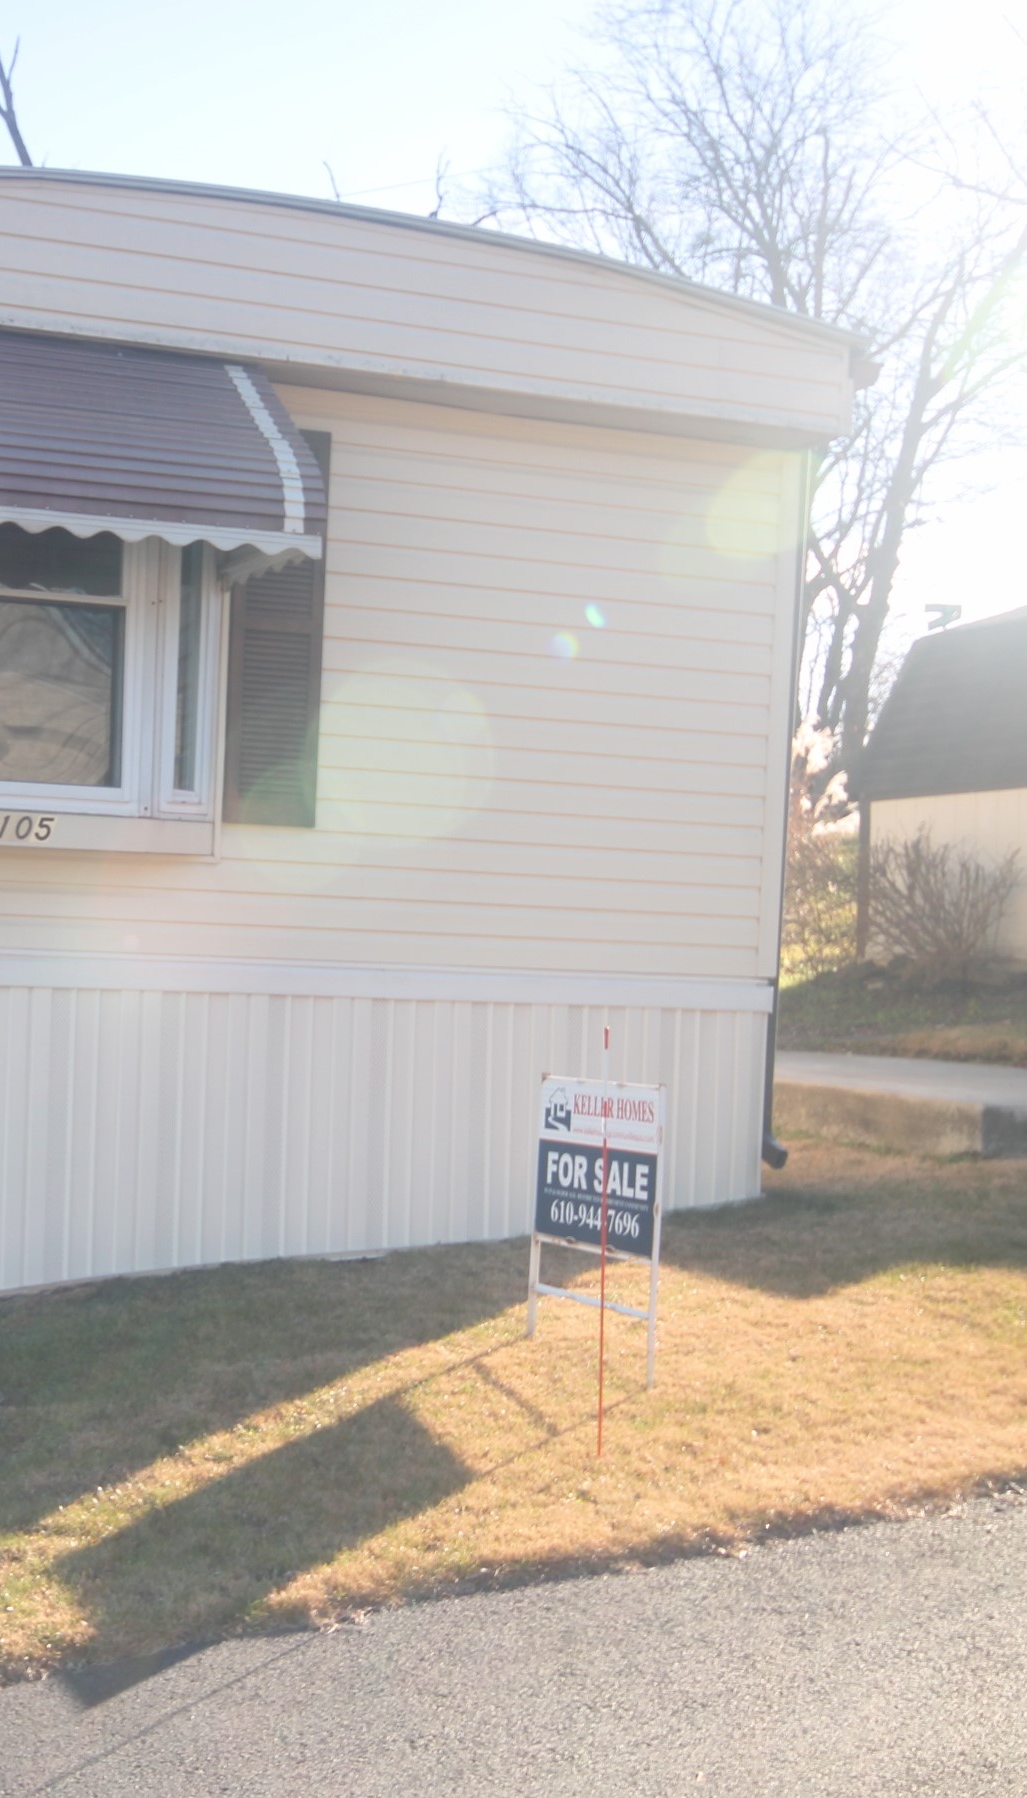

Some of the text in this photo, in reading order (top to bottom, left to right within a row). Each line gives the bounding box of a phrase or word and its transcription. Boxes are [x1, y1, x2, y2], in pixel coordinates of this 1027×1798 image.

[617, 1097, 655, 1124] HOMES
[546, 1150, 588, 1190] FOR
[593, 1156, 650, 1201] SALE
[550, 1198, 641, 1239] 610-9447696
